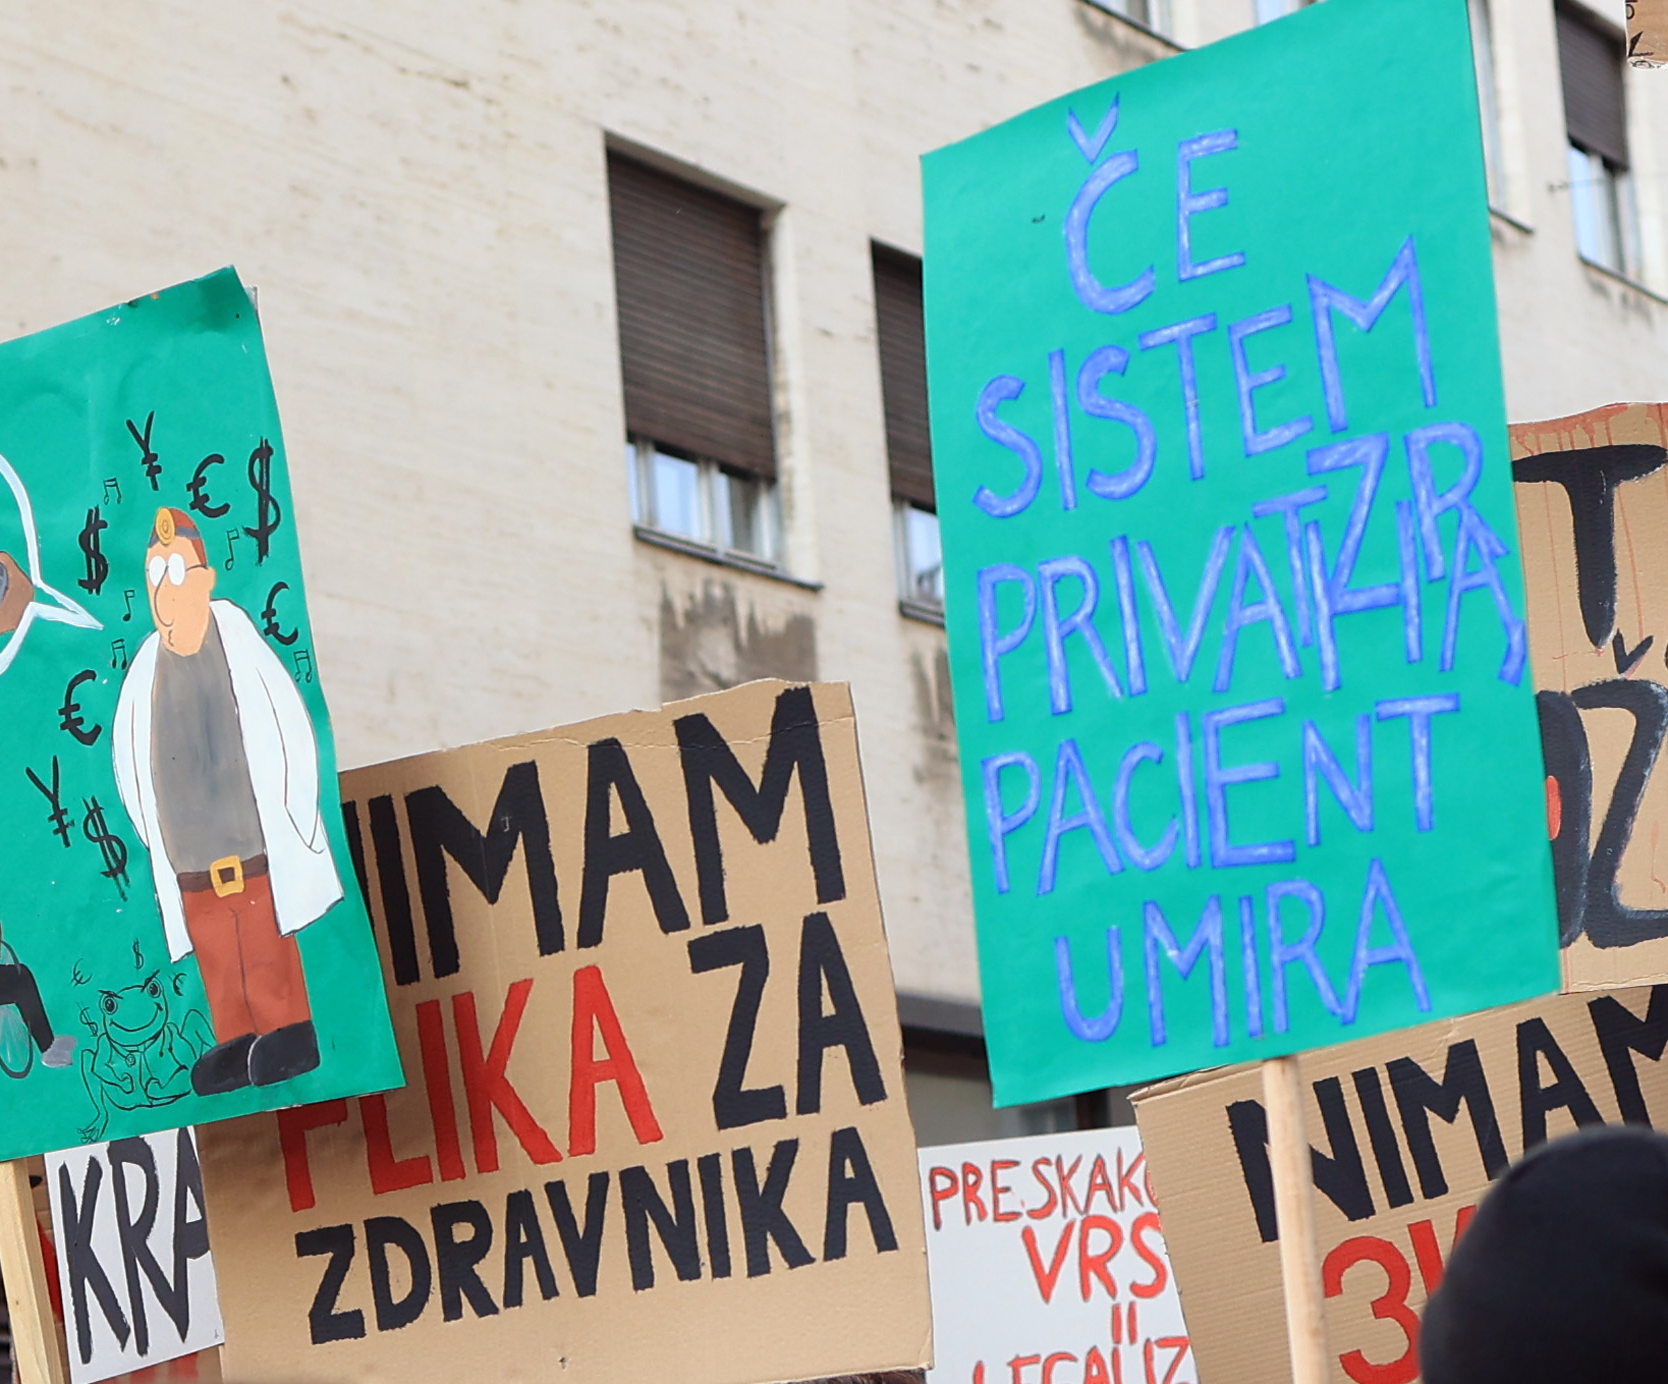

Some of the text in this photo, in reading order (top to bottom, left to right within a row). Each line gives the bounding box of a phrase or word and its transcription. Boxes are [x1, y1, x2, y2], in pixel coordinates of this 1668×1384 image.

[1063, 90, 1246, 314] ČE
[971, 233, 1438, 520] SISTEM
[342, 686, 846, 986] IMAM
[980, 693, 1460, 895] PACIENT
[687, 911, 888, 1131] ZA
[1054, 858, 1432, 1048] UMIRA
[294, 1125, 899, 1345] ZDRAVNIKA
[929, 1147, 1159, 1232] PRESKAK
